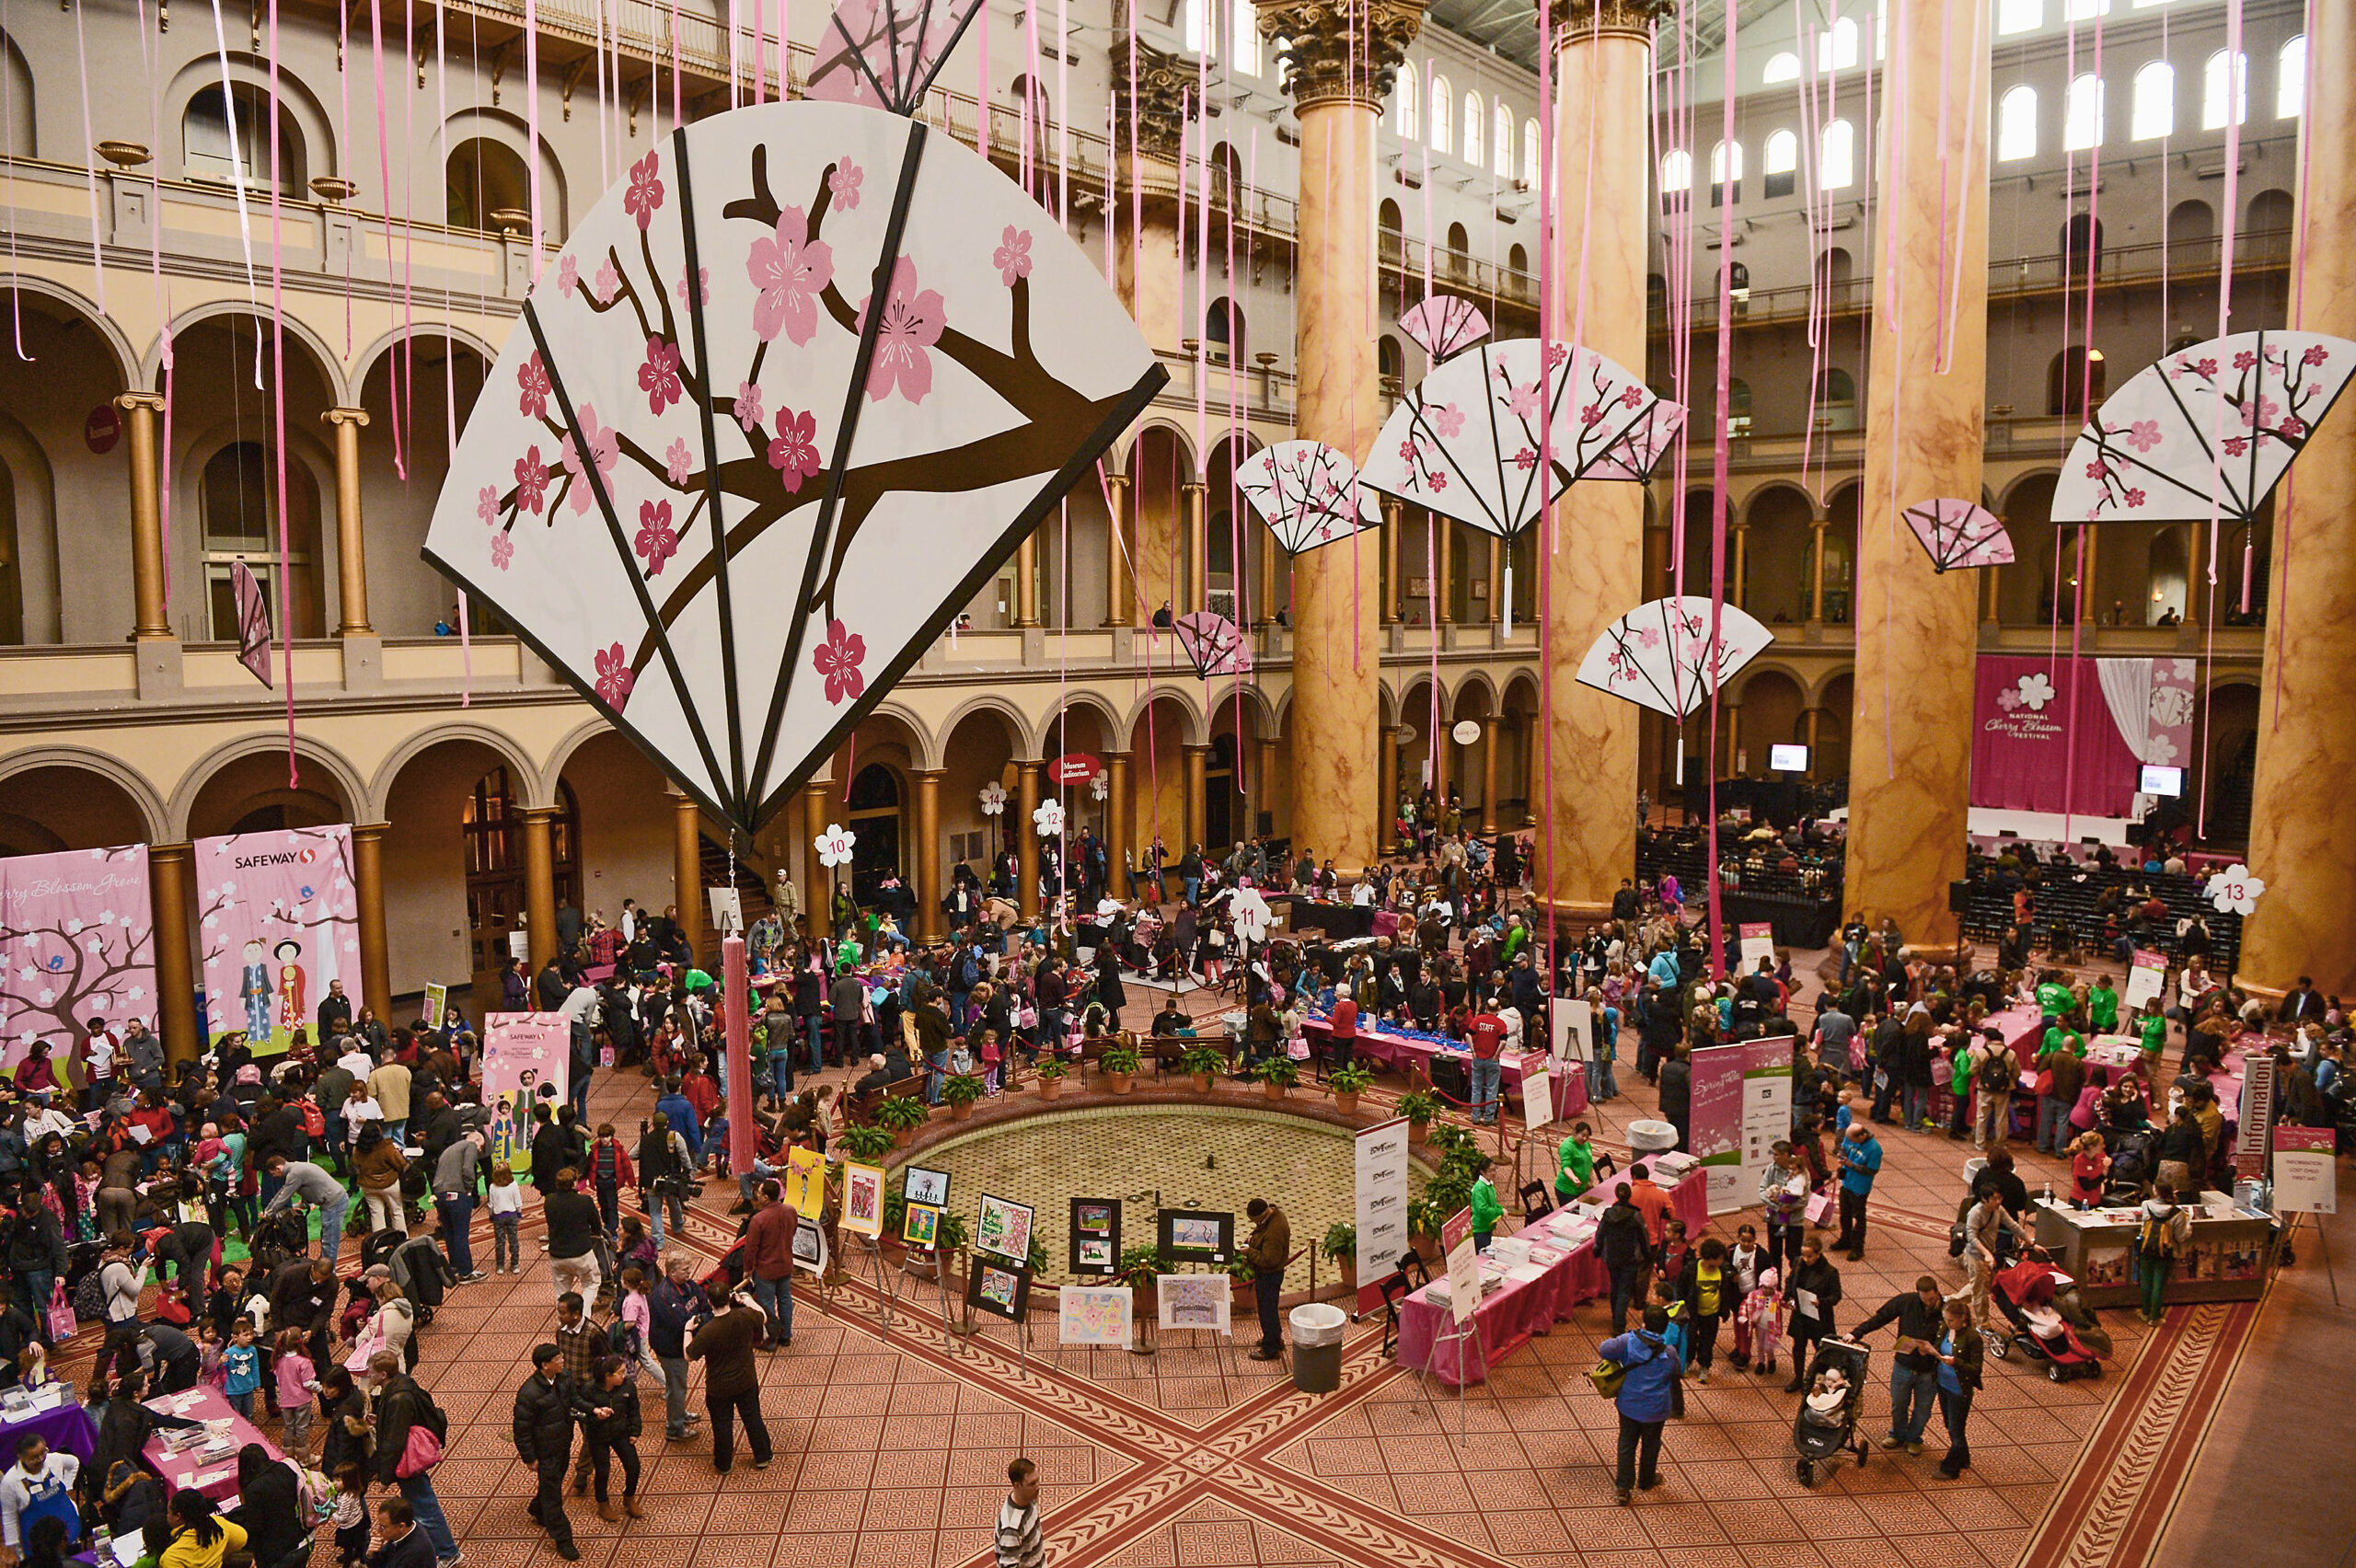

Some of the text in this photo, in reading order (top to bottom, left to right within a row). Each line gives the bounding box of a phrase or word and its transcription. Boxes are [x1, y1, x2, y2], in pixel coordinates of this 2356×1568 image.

[1984, 719, 2062, 736] Cherry Blossom
[1100, 781, 1108, 791] 15
[989, 794, 999, 805] 14
[1046, 813, 1057, 824] 12
[829, 839, 845, 855] 10
[235, 851, 297, 870] SAFEWAY
[31, 877, 93, 897] Blossom
[94, 873, 141, 896] Grove
[2223, 883, 2244, 900] 13
[1241, 907, 1254, 927] 11
[1479, 1022, 1496, 1032] STAFF
[1693, 1079, 1726, 1098] Spring
[2243, 1061, 2270, 1152] Information
[34, 1124, 52, 1136] GAP
